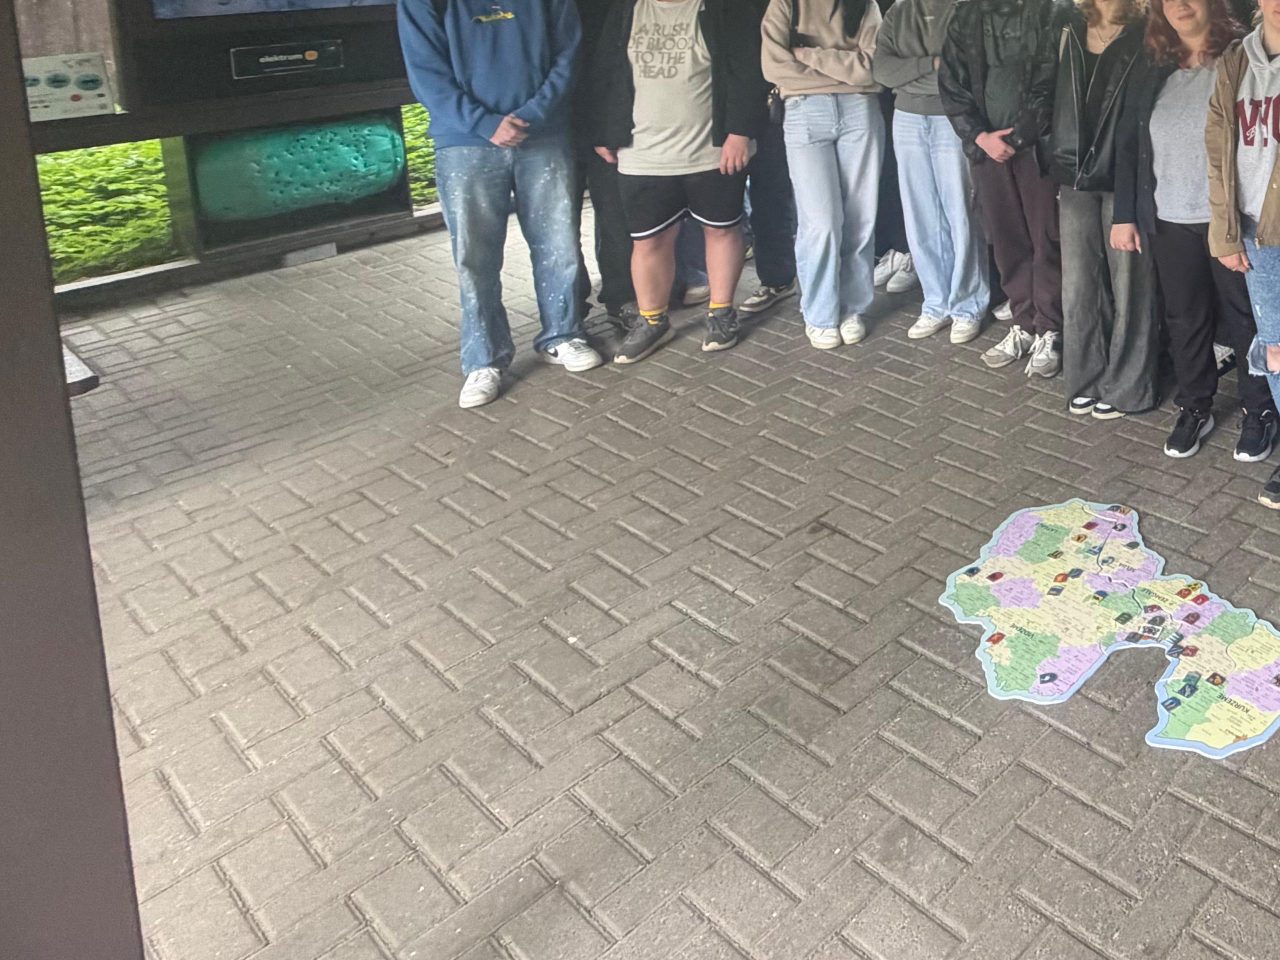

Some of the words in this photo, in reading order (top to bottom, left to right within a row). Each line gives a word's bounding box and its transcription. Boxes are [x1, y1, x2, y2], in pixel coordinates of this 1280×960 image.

[635, 24, 649, 36] A
[652, 22, 690, 37] RUSH
[633, 50, 654, 65] TO
[658, 51, 686, 65] THE
[639, 65, 679, 79] HEAD
[1216, 692, 1251, 714] KURZEME
